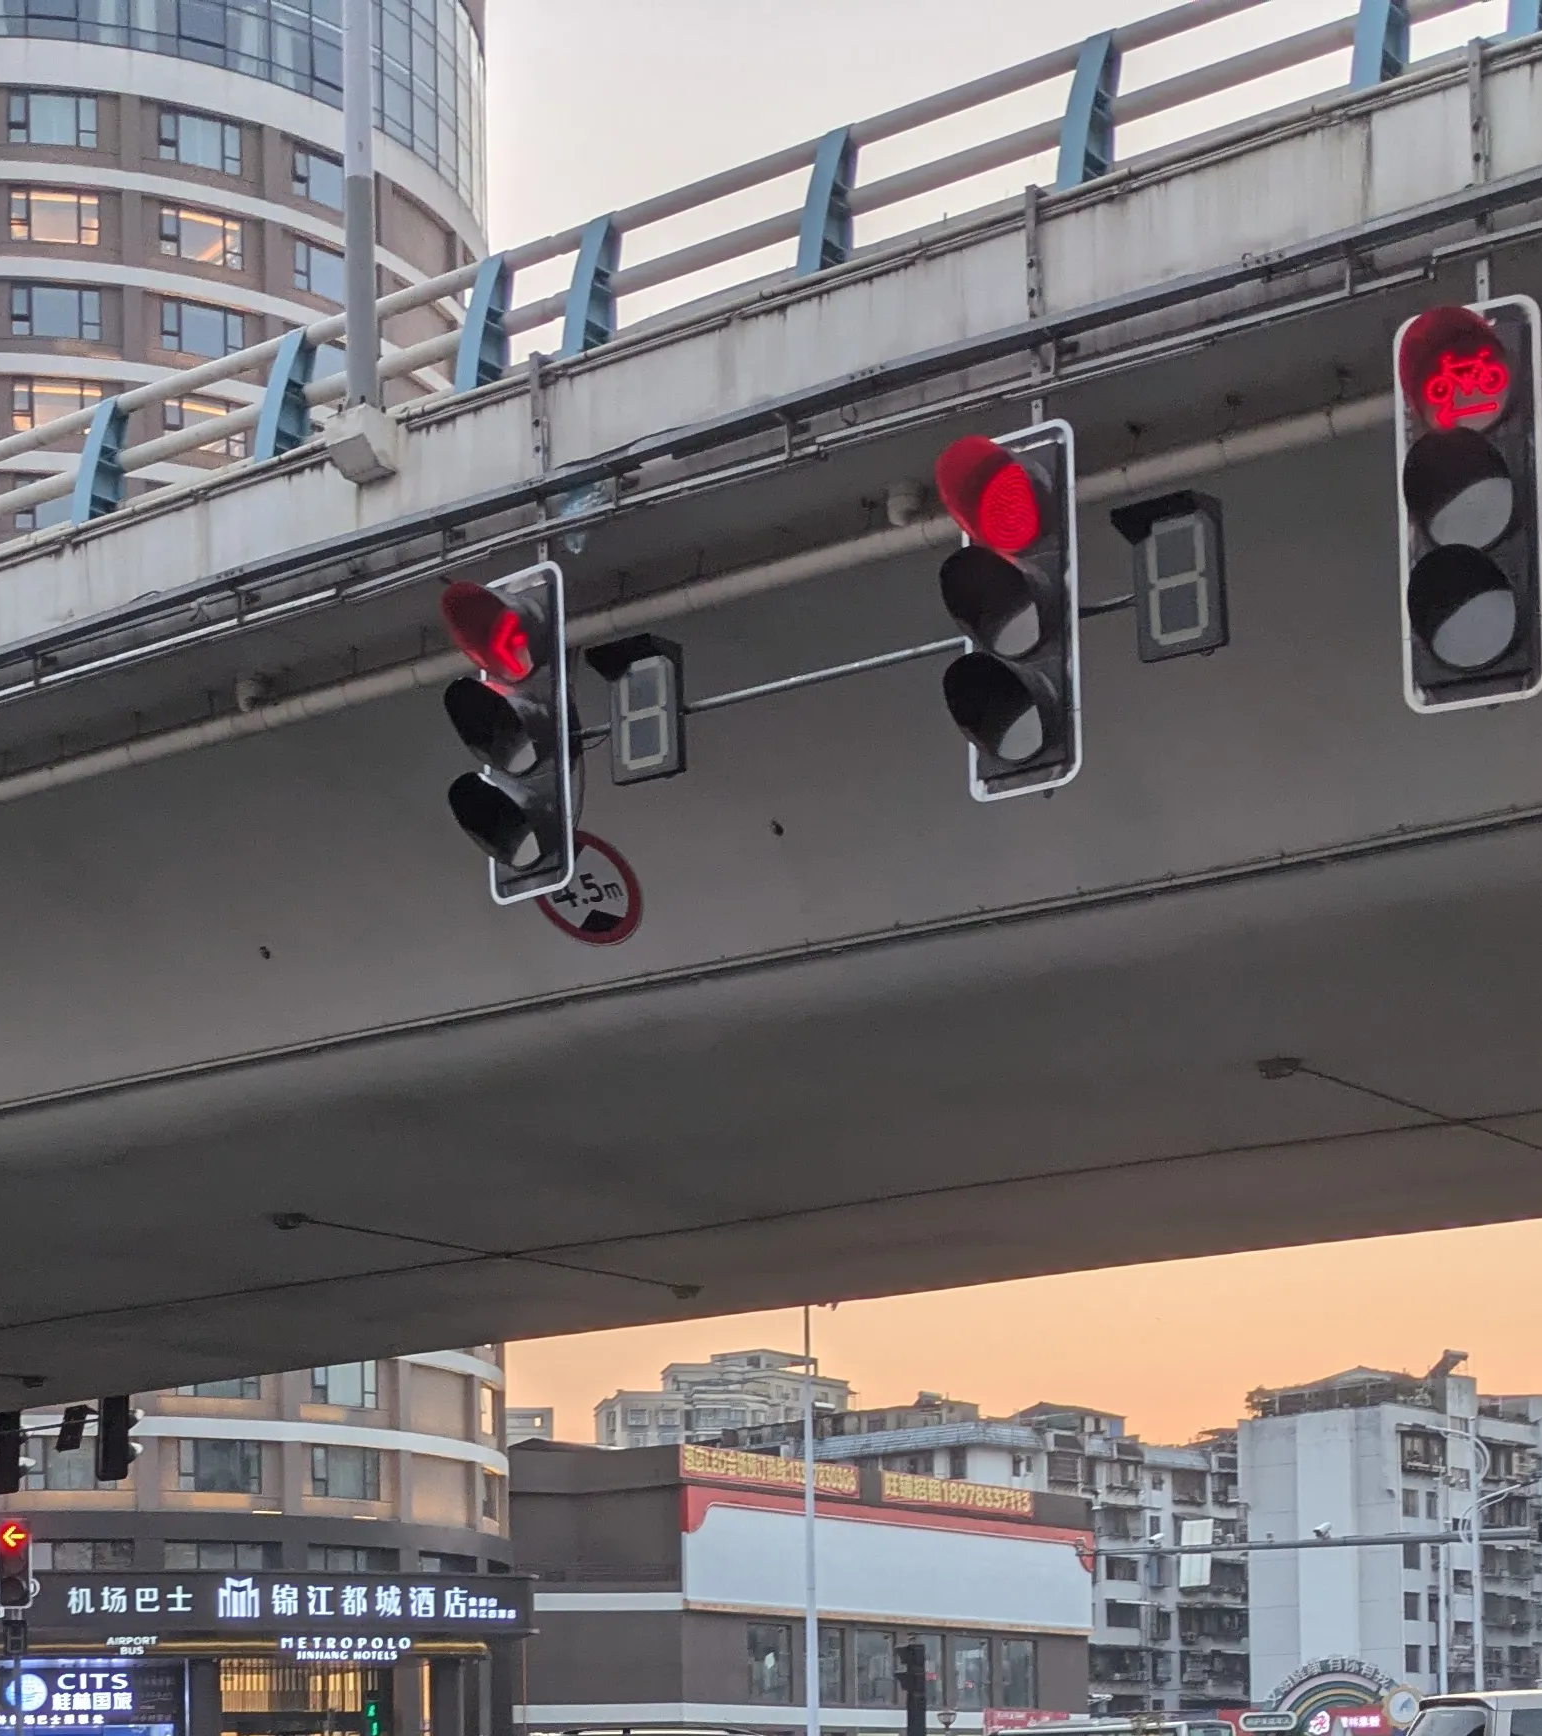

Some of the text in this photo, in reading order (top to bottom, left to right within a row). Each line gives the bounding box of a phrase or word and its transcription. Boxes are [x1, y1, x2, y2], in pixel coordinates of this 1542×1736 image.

[553, 872, 625, 908] 4.5m
[67, 1585, 193, 1614] 机场巴士
[271, 1584, 469, 1618] 锦江都城酒店
[106, 1635, 158, 1646] AIRPORT
[280, 1636, 412, 1650] METROPOLO
[119, 1645, 145, 1655] BUS
[296, 1650, 398, 1661] JINJIANG HOTELS
[57, 1673, 129, 1690] CITS
[52, 1692, 133, 1711] 桂林国旅
